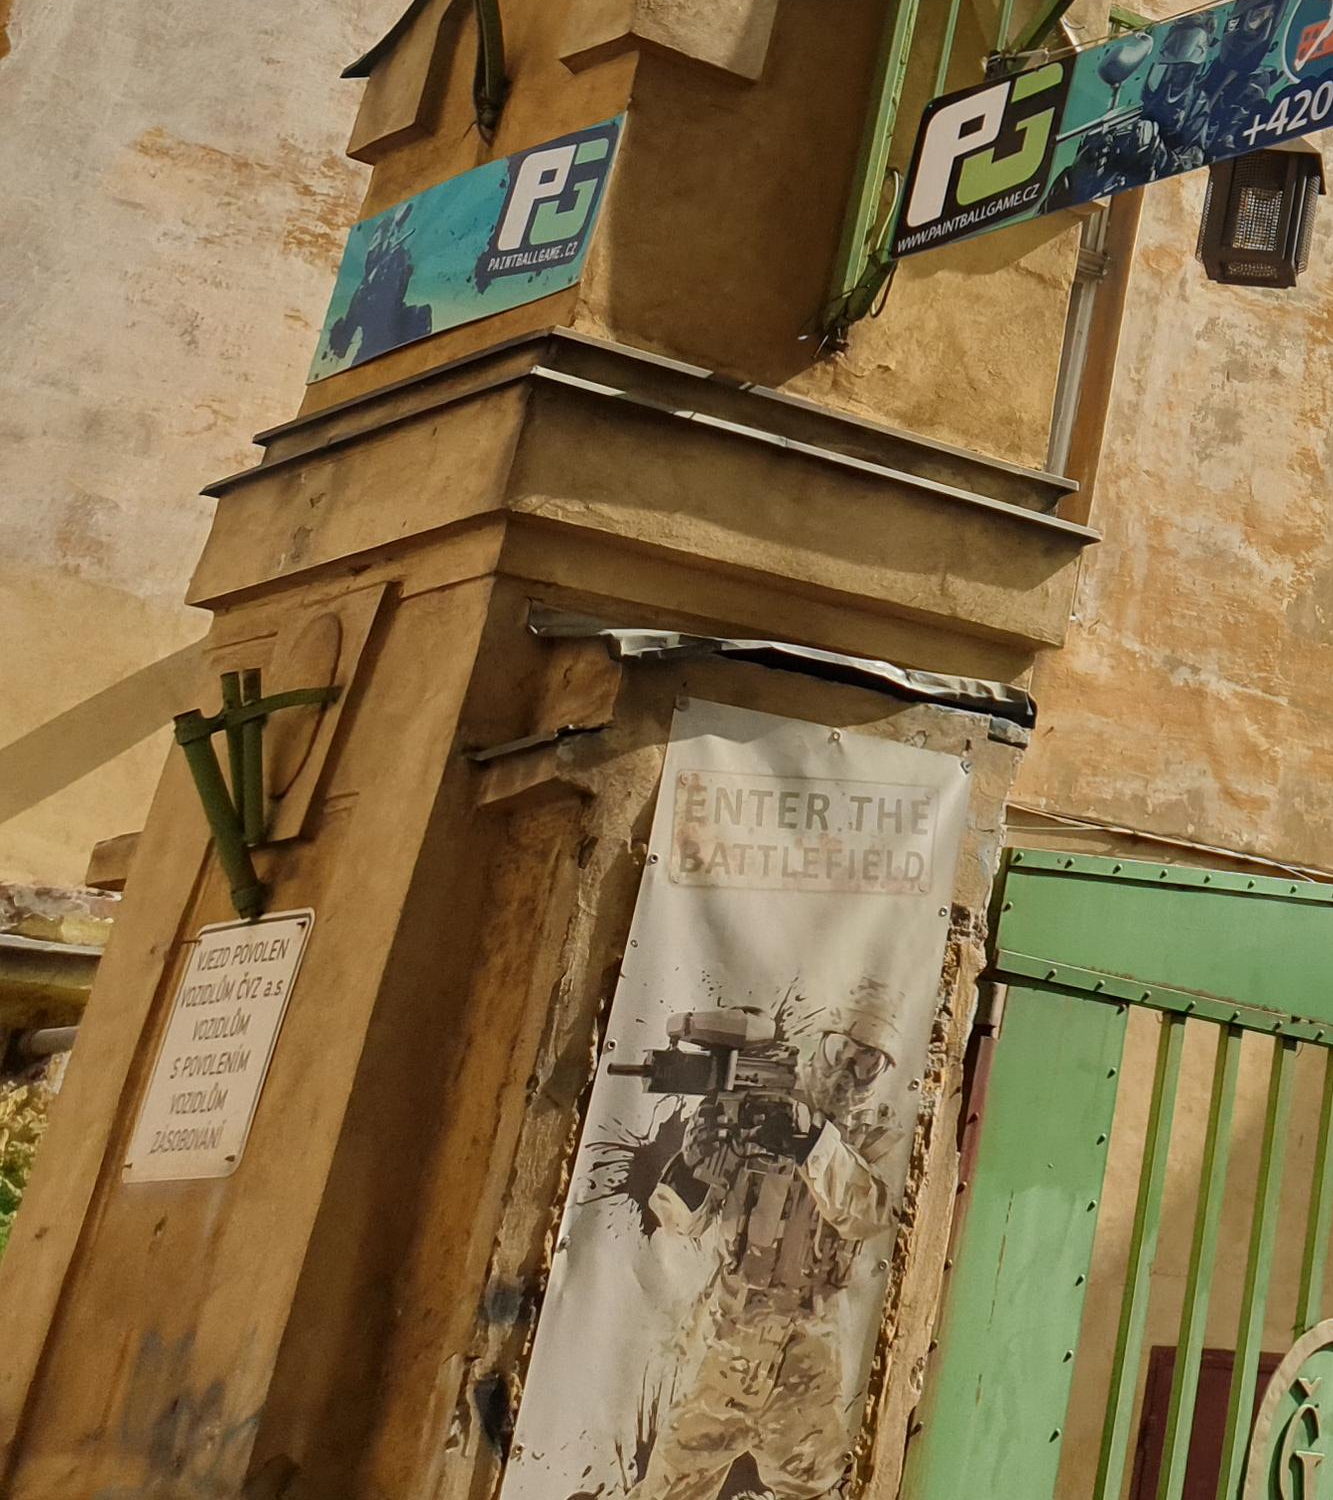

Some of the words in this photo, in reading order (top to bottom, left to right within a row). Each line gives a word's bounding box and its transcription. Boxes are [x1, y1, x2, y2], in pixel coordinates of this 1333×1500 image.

[907, 62, 1065, 228] PG
[497, 137, 610, 251] PG
[897, 183, 1041, 253] WWW.PAINTBALLGAME.CZ
[487, 241, 578, 272] PAINTBALLGAME.CZ
[684, 784, 831, 832] ENTER
[849, 795, 932, 836] THE
[679, 840, 926, 883] BATTLEFIELD
[196, 946, 232, 972] VJEZD
[231, 938, 291, 967] POVOLEN
[180, 974, 235, 1009] VOZIDLŮM
[236, 971, 260, 1001] ČVZ
[191, 1007, 252, 1042] VOZIDLŮM
[170, 1056, 182, 1080] S
[181, 1045, 252, 1078] POVOLENÍM
[168, 1082, 229, 1115] VOZIDLŮM
[148, 1118, 228, 1155] ZÁSOBOVÁNÍ
